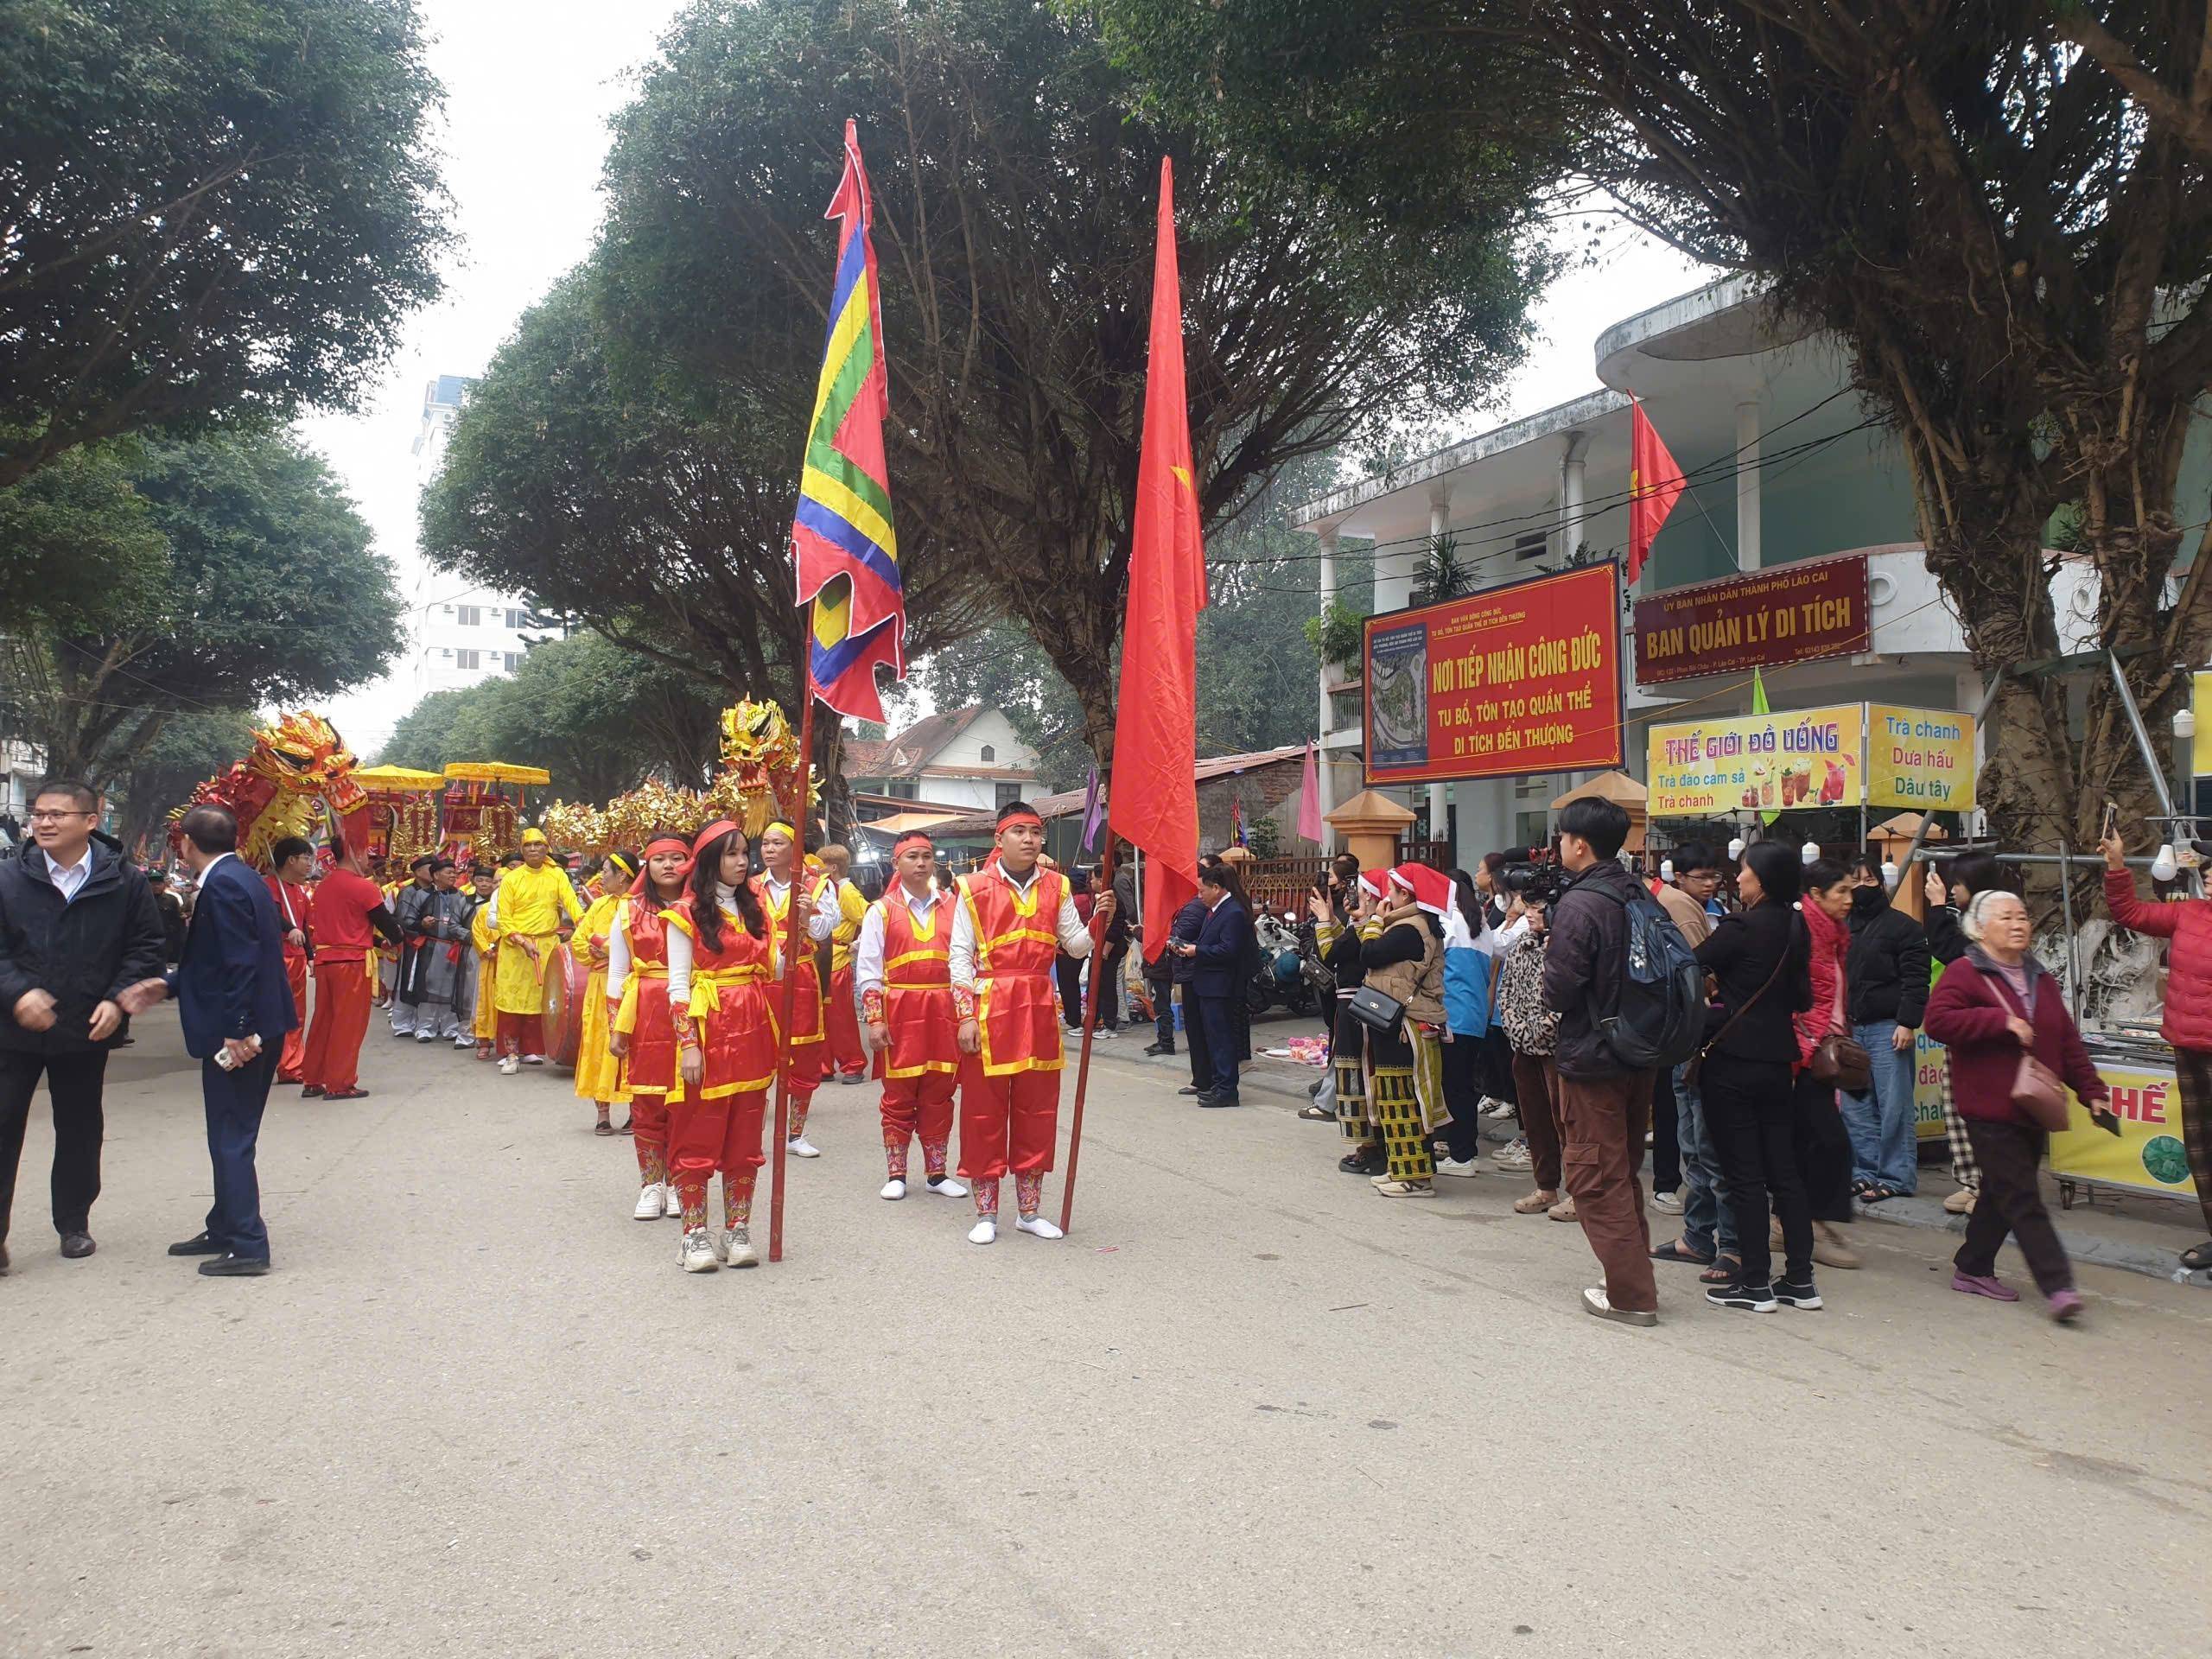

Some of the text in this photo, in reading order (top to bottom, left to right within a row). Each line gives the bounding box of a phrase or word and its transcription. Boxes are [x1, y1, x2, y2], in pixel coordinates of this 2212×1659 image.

[1663, 571, 1828, 613] ỦY BAN NHÂN DÂN THÀNH PHỐ LÀO CAI
[1646, 594, 1851, 659] BAN QUẢN LÝ DI TÍCH
[1433, 625, 1602, 693] NƠI TIẾP NHẬN CÔNG ĐỨC
[1438, 709, 1452, 728] TU
[1476, 700, 1498, 721] TÔN
[1502, 699, 1525, 724] TẠO
[1529, 687, 1562, 716] QUẦN
[1567, 680, 1592, 710] THỂ
[1454, 722, 1573, 755] DI TÍCH ĐỀN THƯỢNG
[1665, 716, 1840, 766] THẾ GIỚI ĐỒ UỐNG
[1885, 716, 1961, 741] Trà chanh
[1893, 747, 1954, 769] Dưa hấu
[1658, 767, 1745, 788] Trà đào cam sả
[1895, 777, 1951, 802] Dâu tây
[1658, 793, 1714, 810] Trà chanh
